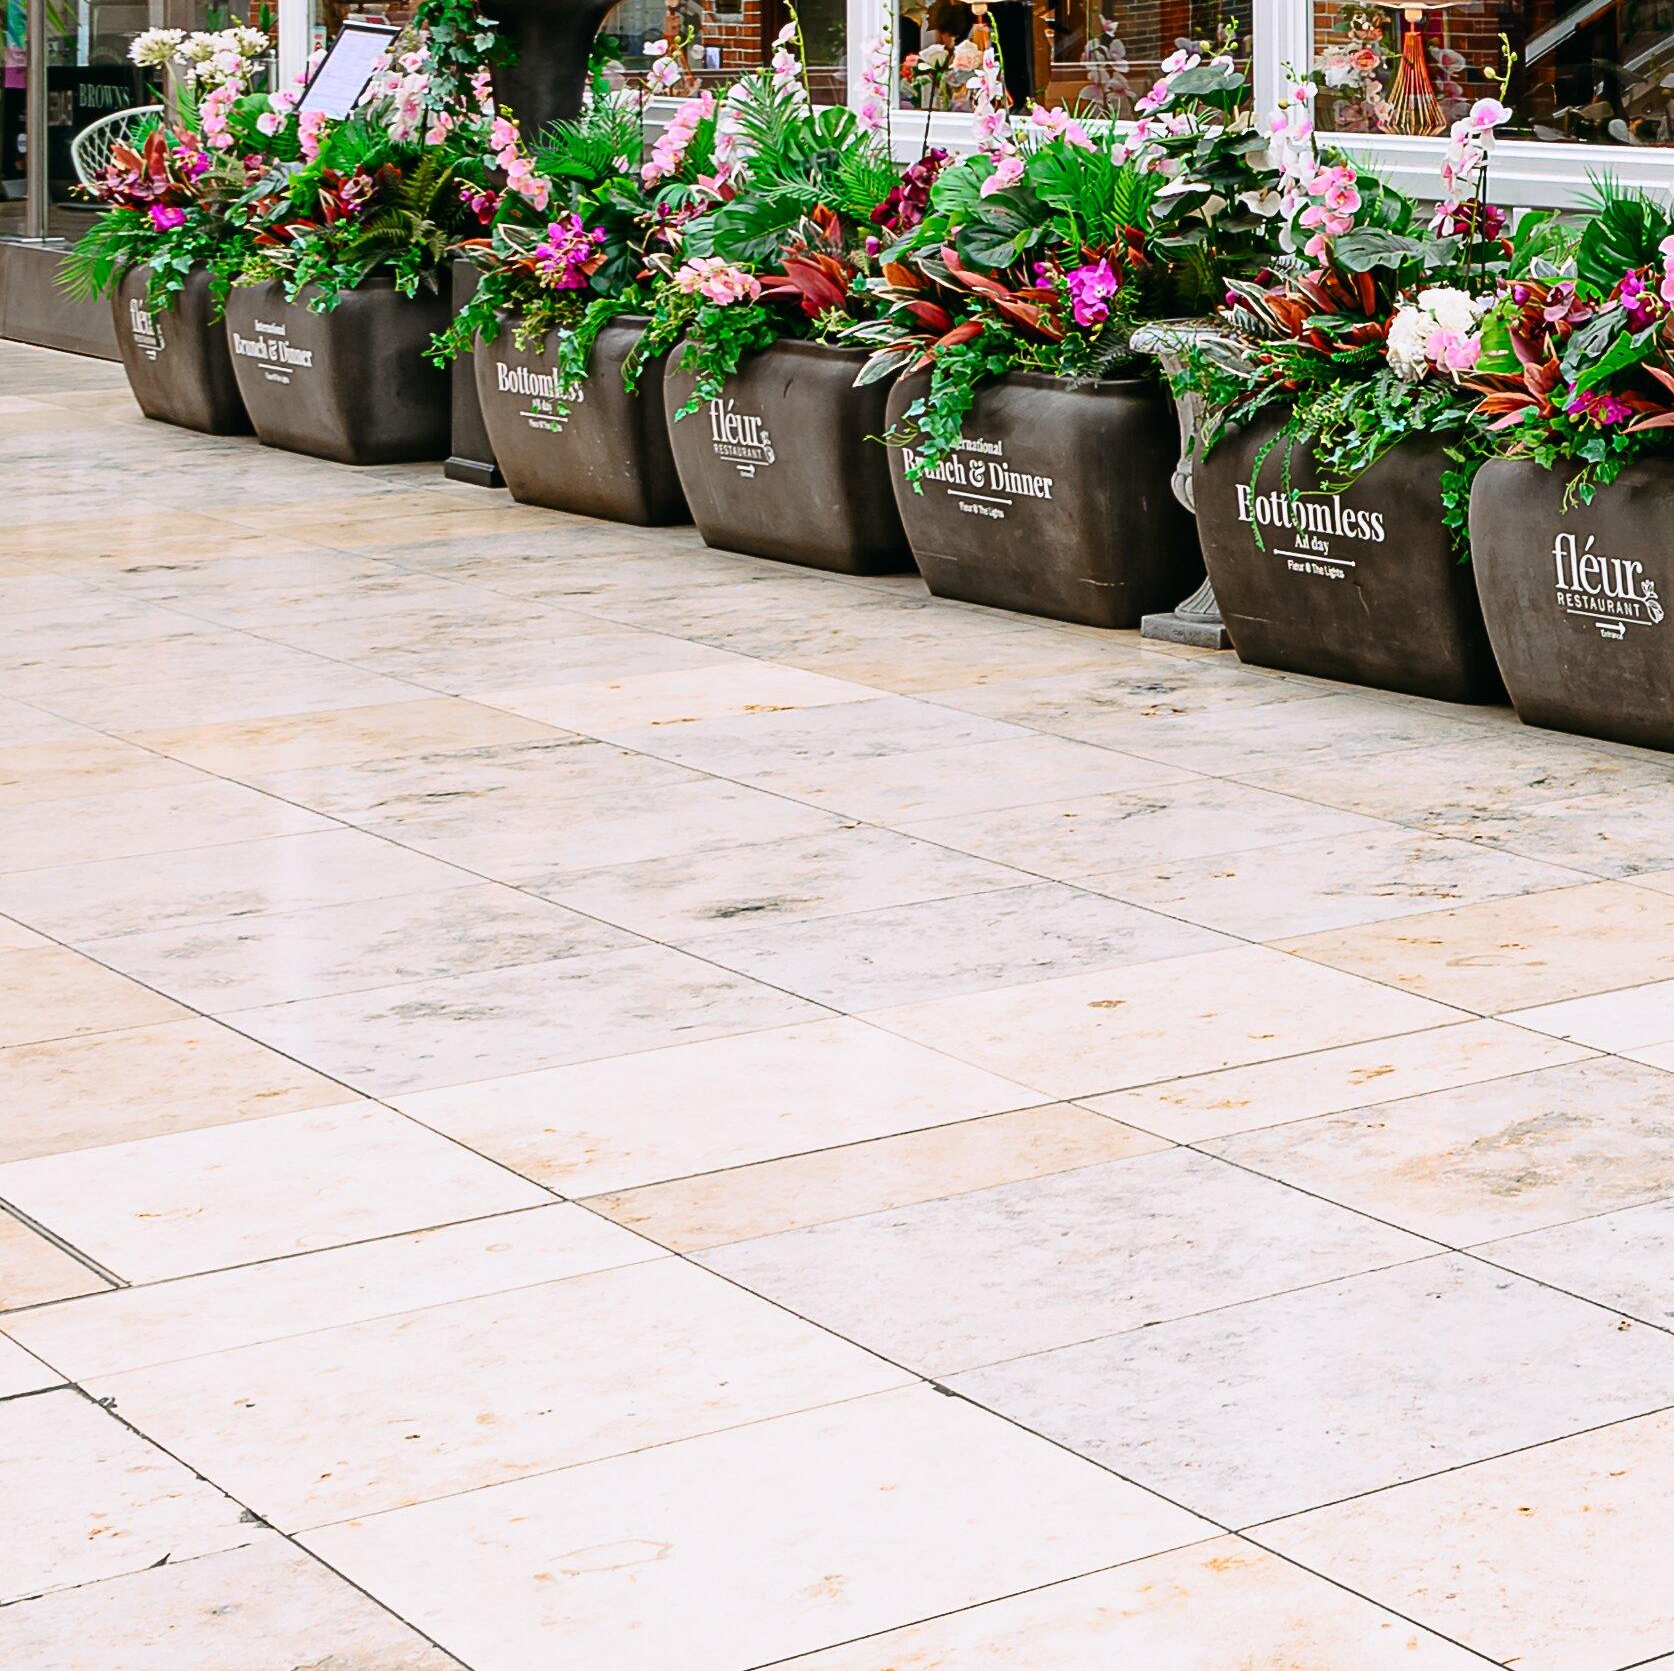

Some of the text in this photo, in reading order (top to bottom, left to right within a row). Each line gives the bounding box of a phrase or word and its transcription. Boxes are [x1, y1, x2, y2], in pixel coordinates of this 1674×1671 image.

[708, 398, 763, 447] fléur
[969, 459, 986, 488] &
[988, 462, 1053, 499] Dinner
[1551, 532, 1645, 601] fléur
[1556, 591, 1641, 618] RESTAURANT
